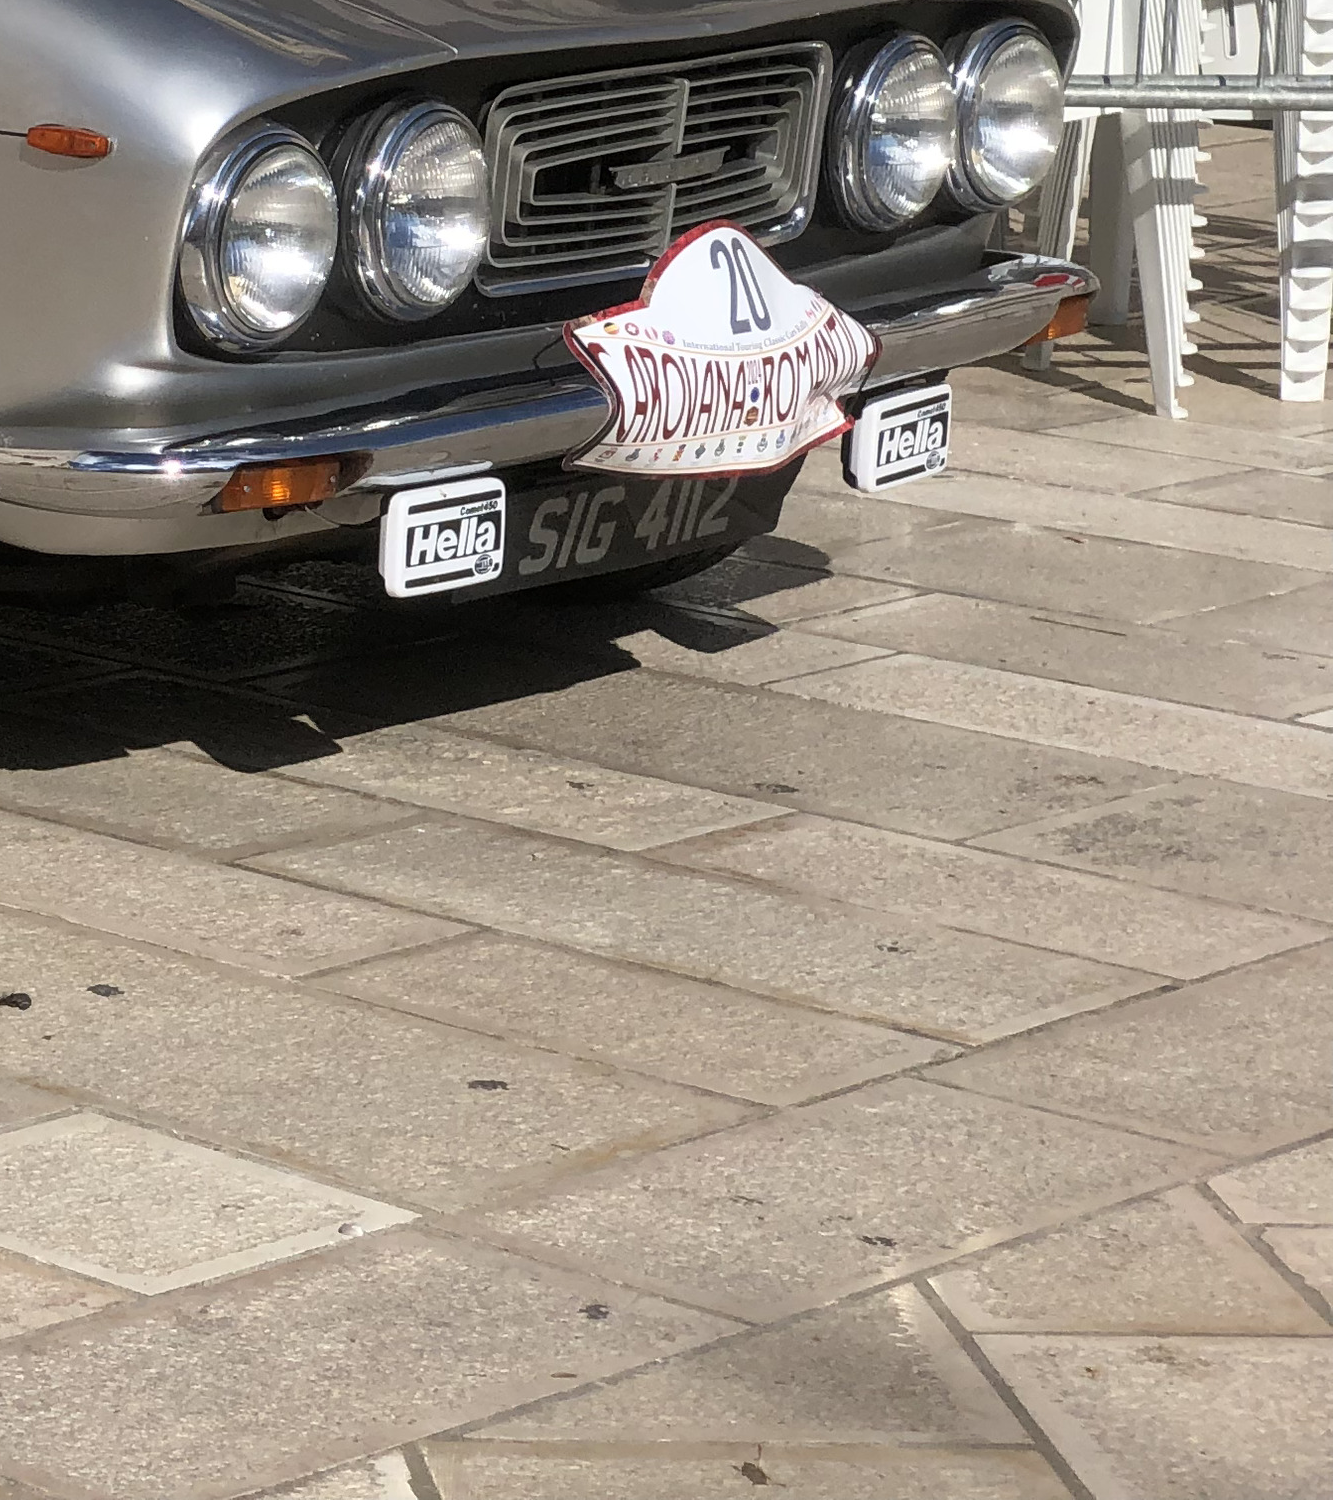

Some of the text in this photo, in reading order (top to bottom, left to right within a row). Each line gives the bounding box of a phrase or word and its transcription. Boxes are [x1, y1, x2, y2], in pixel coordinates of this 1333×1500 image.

[710, 237, 772, 335] 20
[682, 339, 735, 352] International
[587, 341, 746, 444] CAROVANA
[879, 417, 944, 466] Hella
[410, 516, 496, 566] Hella
[518, 477, 740, 575] SIG 4112
